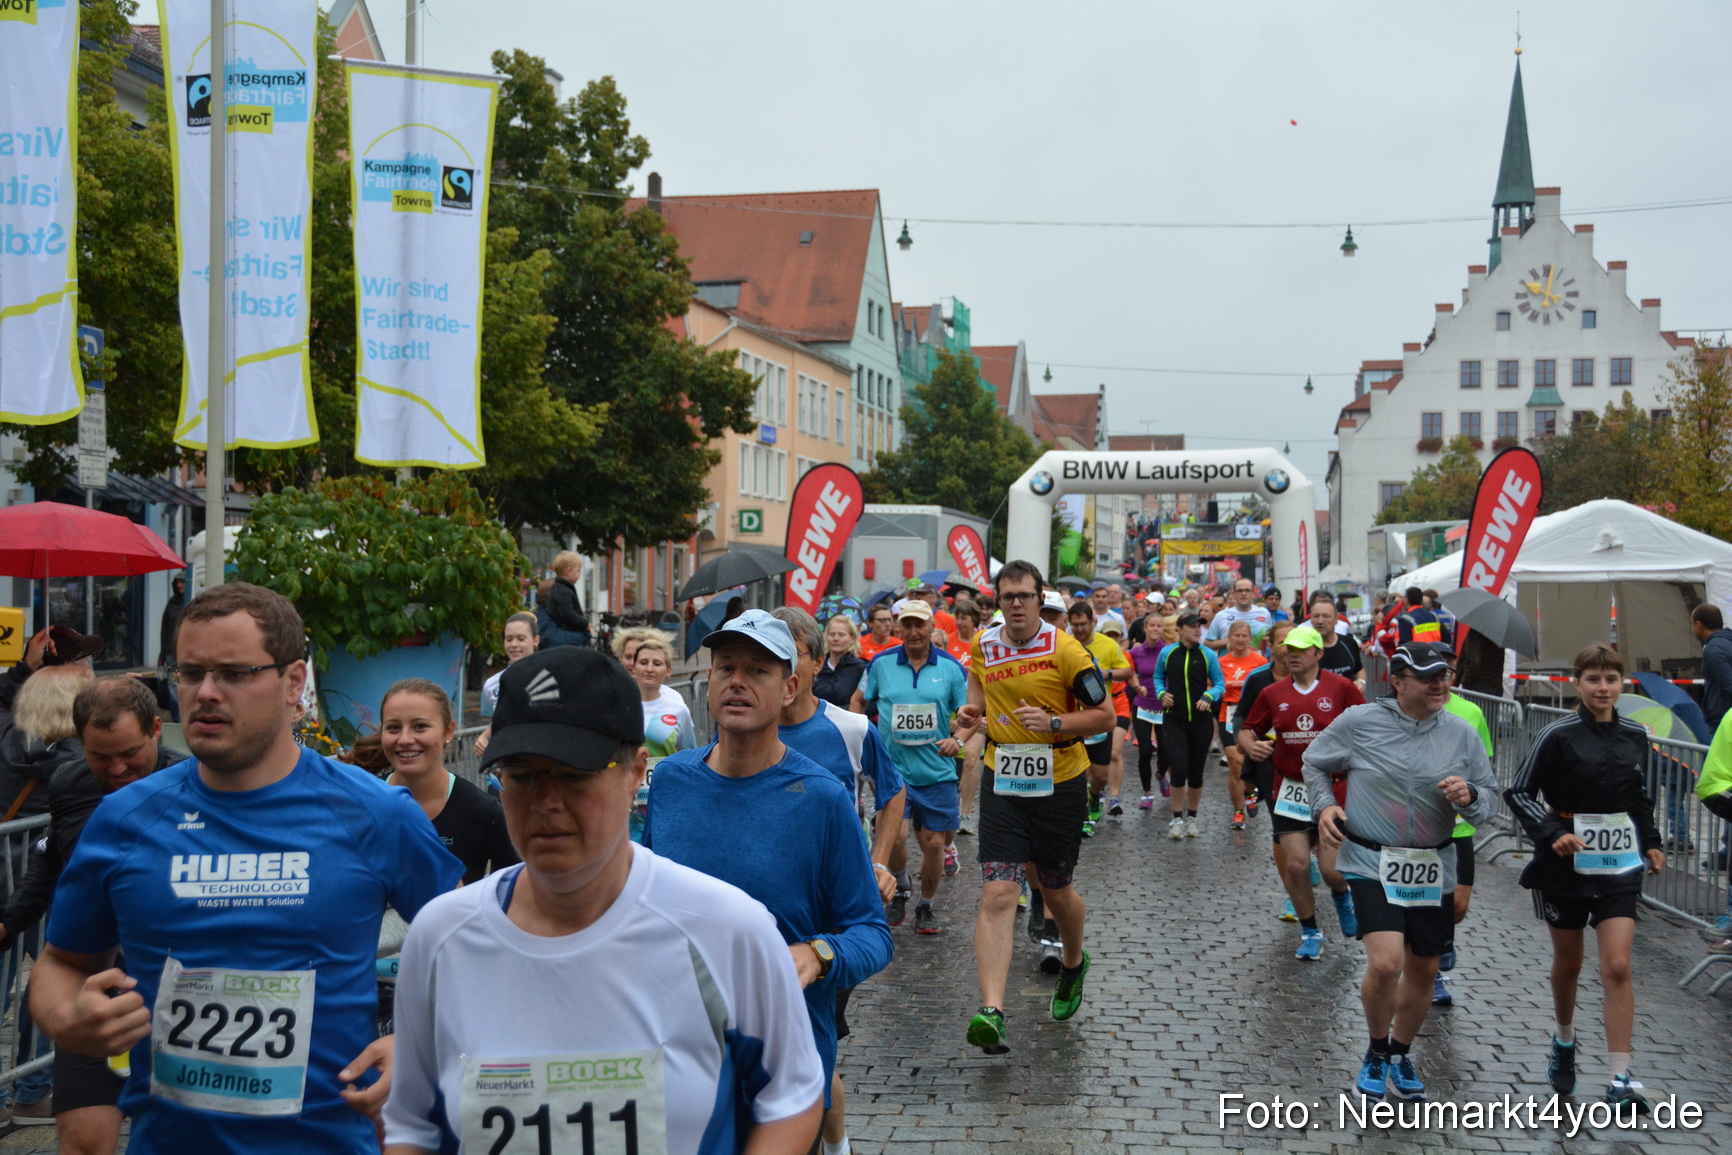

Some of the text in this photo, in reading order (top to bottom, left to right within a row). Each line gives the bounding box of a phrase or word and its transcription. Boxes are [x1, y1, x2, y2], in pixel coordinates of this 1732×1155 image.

[364, 160, 432, 175] Kampagne
[364, 173, 438, 191] Fairtrade
[394, 194, 432, 208] Towns
[362, 276, 449, 302] Wir sind
[363, 307, 470, 334] Fairtrade-
[367, 339, 430, 360] Stadt!
[1062, 459, 1255, 483] BMW Laufsport
[742, 512, 759, 530] D
[1467, 468, 1532, 591] REWE
[789, 480, 852, 606] REWE
[1201, 543, 1224, 553] ZIEL
[985, 660, 1058, 684] MAX BÖGL
[897, 714, 933, 730] 2654
[1001, 756, 1048, 777] 2769
[1010, 780, 1037, 790] Florian
[177, 821, 205, 831] erima
[1583, 828, 1632, 851] 2025
[170, 851, 310, 882] HUBER
[1602, 857, 1618, 866] Nia
[1386, 861, 1439, 884] 2026
[199, 882, 304, 894] TECHNOLOGY
[1395, 889, 1425, 899] Norbert
[197, 897, 305, 908] WASTE WATER Solutions
[223, 974, 302, 994] BOCK
[167, 998, 297, 1059] 2223
[176, 1064, 273, 1095] Johannes
[547, 1057, 645, 1085] BOCK
[476, 1078, 535, 1091] NeuerMarkt
[482, 1099, 639, 1155] 2111
